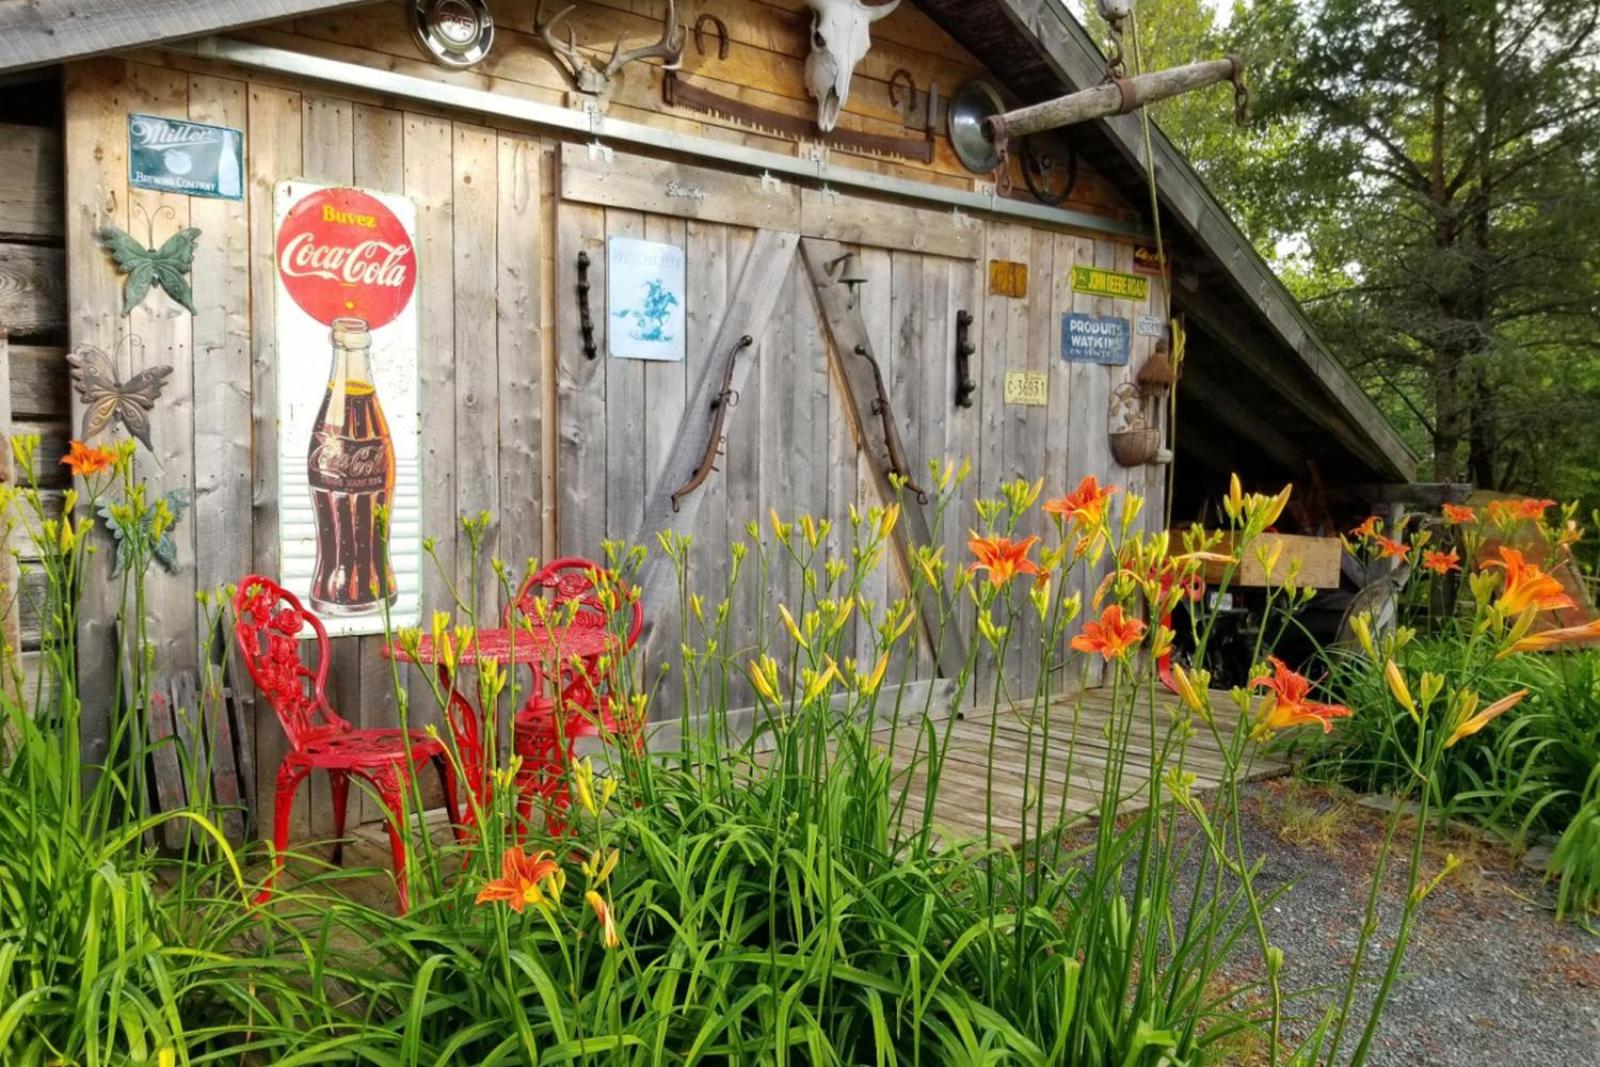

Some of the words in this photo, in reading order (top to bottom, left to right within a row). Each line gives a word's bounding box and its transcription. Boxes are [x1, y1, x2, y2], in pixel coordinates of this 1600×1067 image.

[131, 120, 216, 146] Miller
[176, 177, 216, 191] COMPANY
[322, 204, 376, 229] Buvez
[281, 232, 411, 287] Coca-Cola
[1089, 270, 1106, 292] JOHN
[1069, 319, 1123, 336] PRODUITS
[1071, 335, 1122, 350] WATKINS
